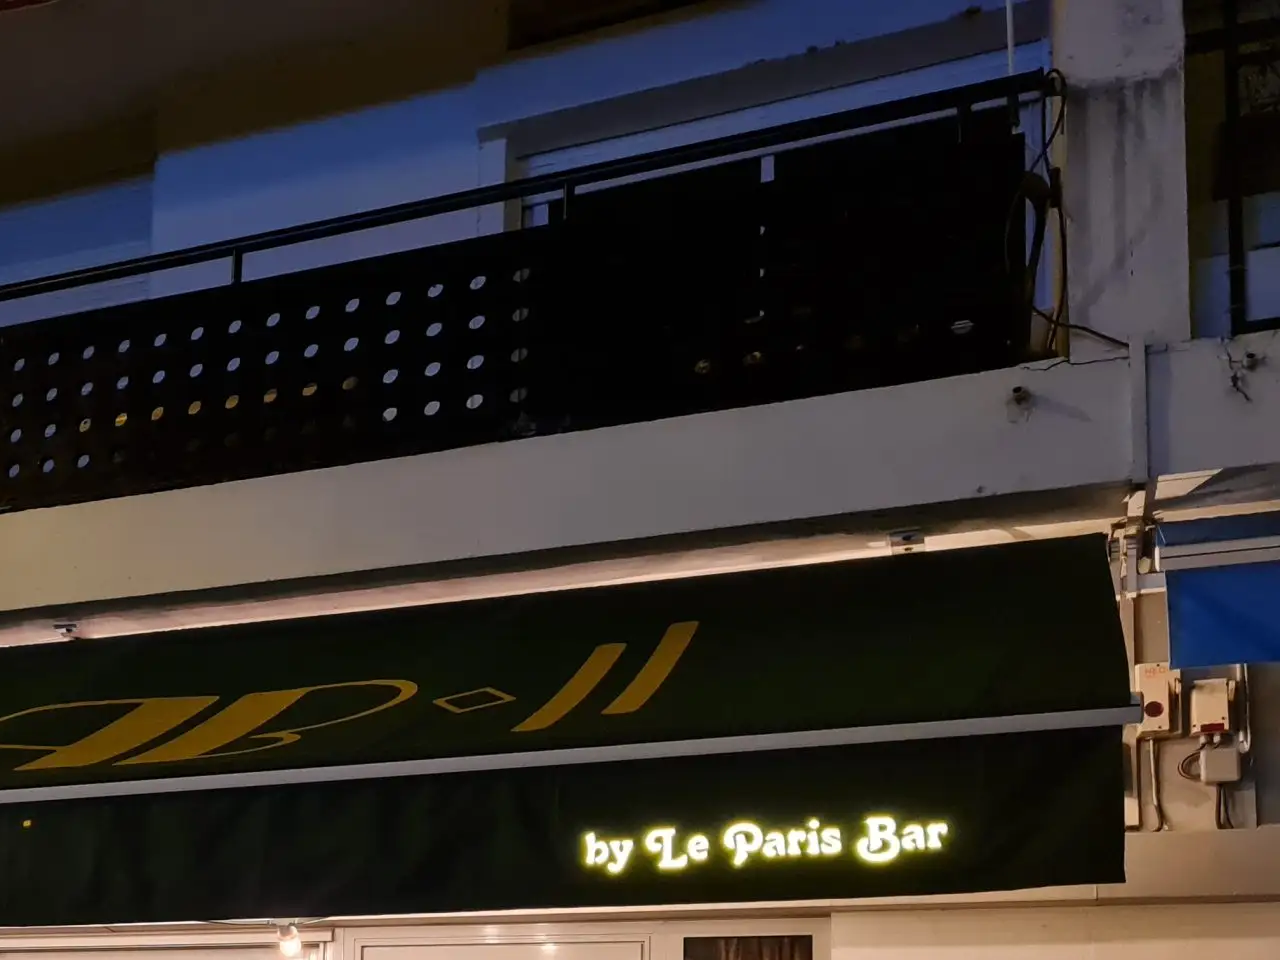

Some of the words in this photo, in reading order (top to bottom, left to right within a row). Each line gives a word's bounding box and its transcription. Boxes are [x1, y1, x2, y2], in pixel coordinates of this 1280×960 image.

[584, 831, 634, 874] by
[645, 827, 710, 869] Le
[723, 818, 843, 867] Paris
[857, 815, 949, 863] Bar
